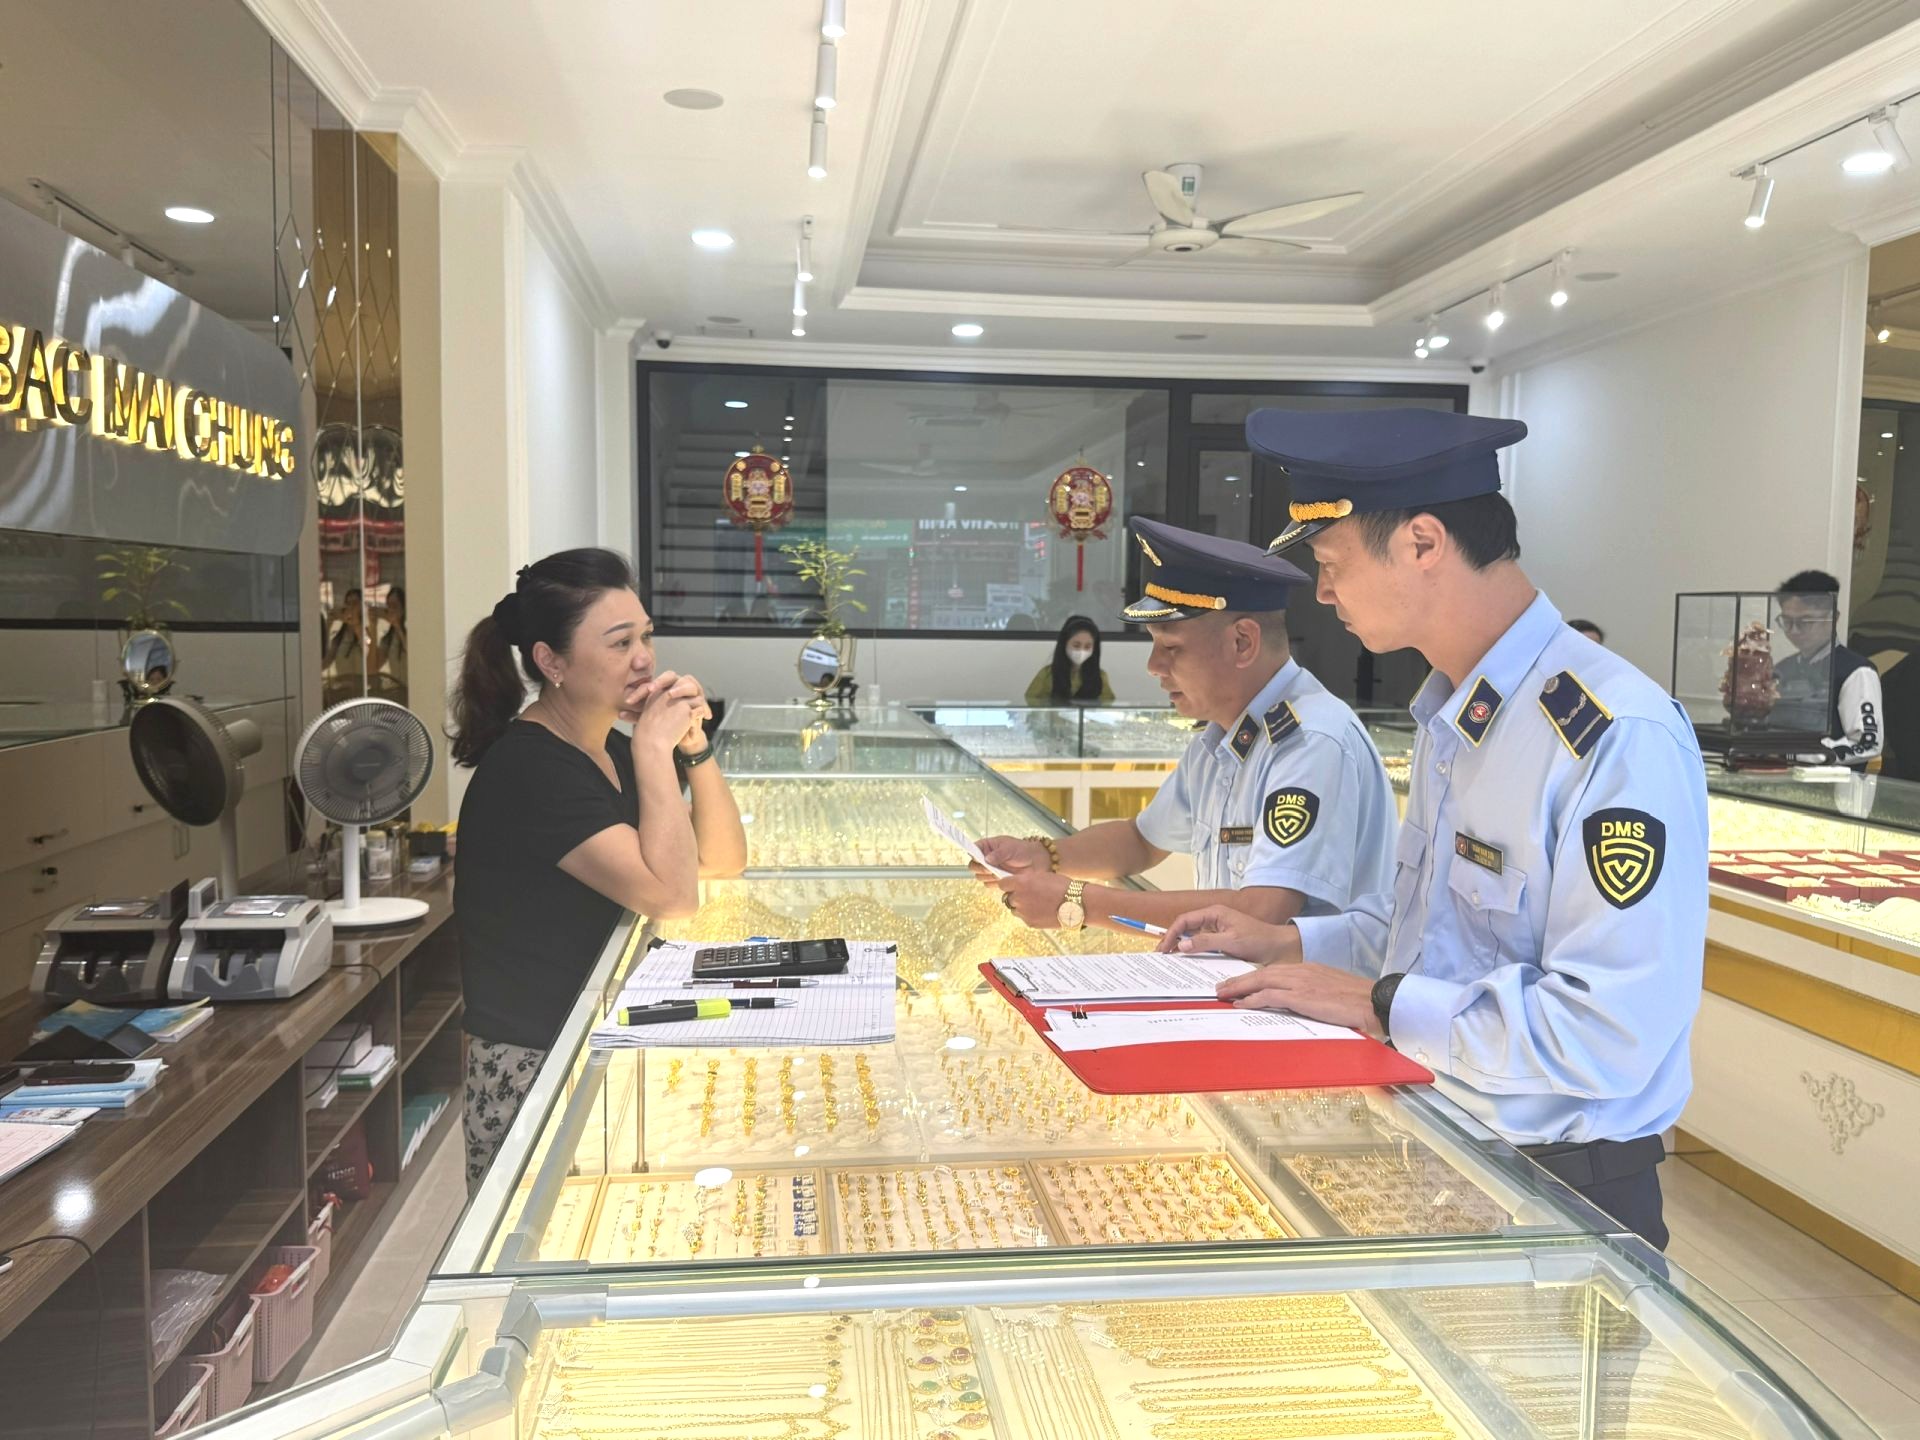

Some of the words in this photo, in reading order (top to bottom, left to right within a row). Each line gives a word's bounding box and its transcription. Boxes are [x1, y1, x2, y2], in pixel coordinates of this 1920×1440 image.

[97, 356, 176, 450] MAI
[177, 386, 296, 480] CHUNG
[1277, 794, 1306, 806] DMS
[1601, 821, 1646, 839] DMS
